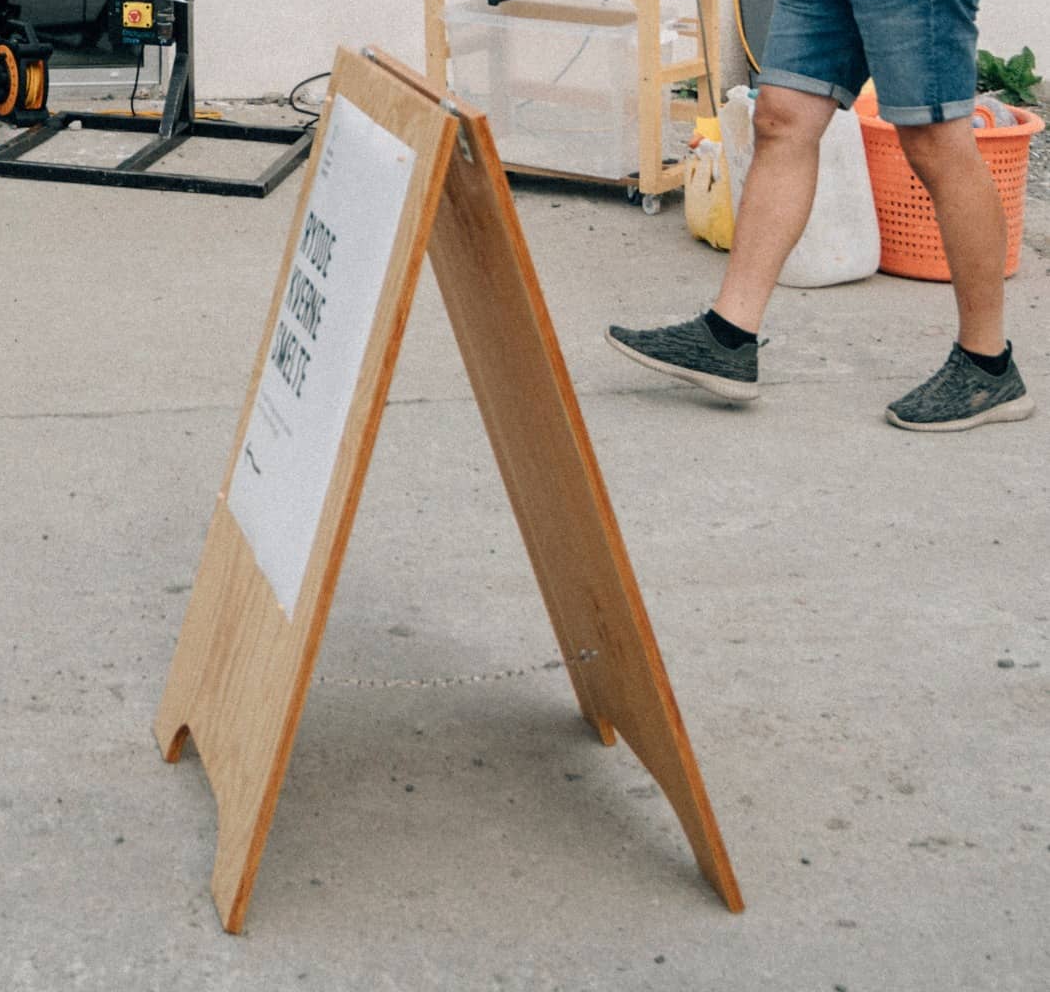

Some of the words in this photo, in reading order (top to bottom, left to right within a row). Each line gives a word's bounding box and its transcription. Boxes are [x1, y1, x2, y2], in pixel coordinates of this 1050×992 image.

[299, 210, 336, 278] RYDDE
[285, 263, 326, 341] KVERNE
[270, 320, 311, 398] SMELTE
